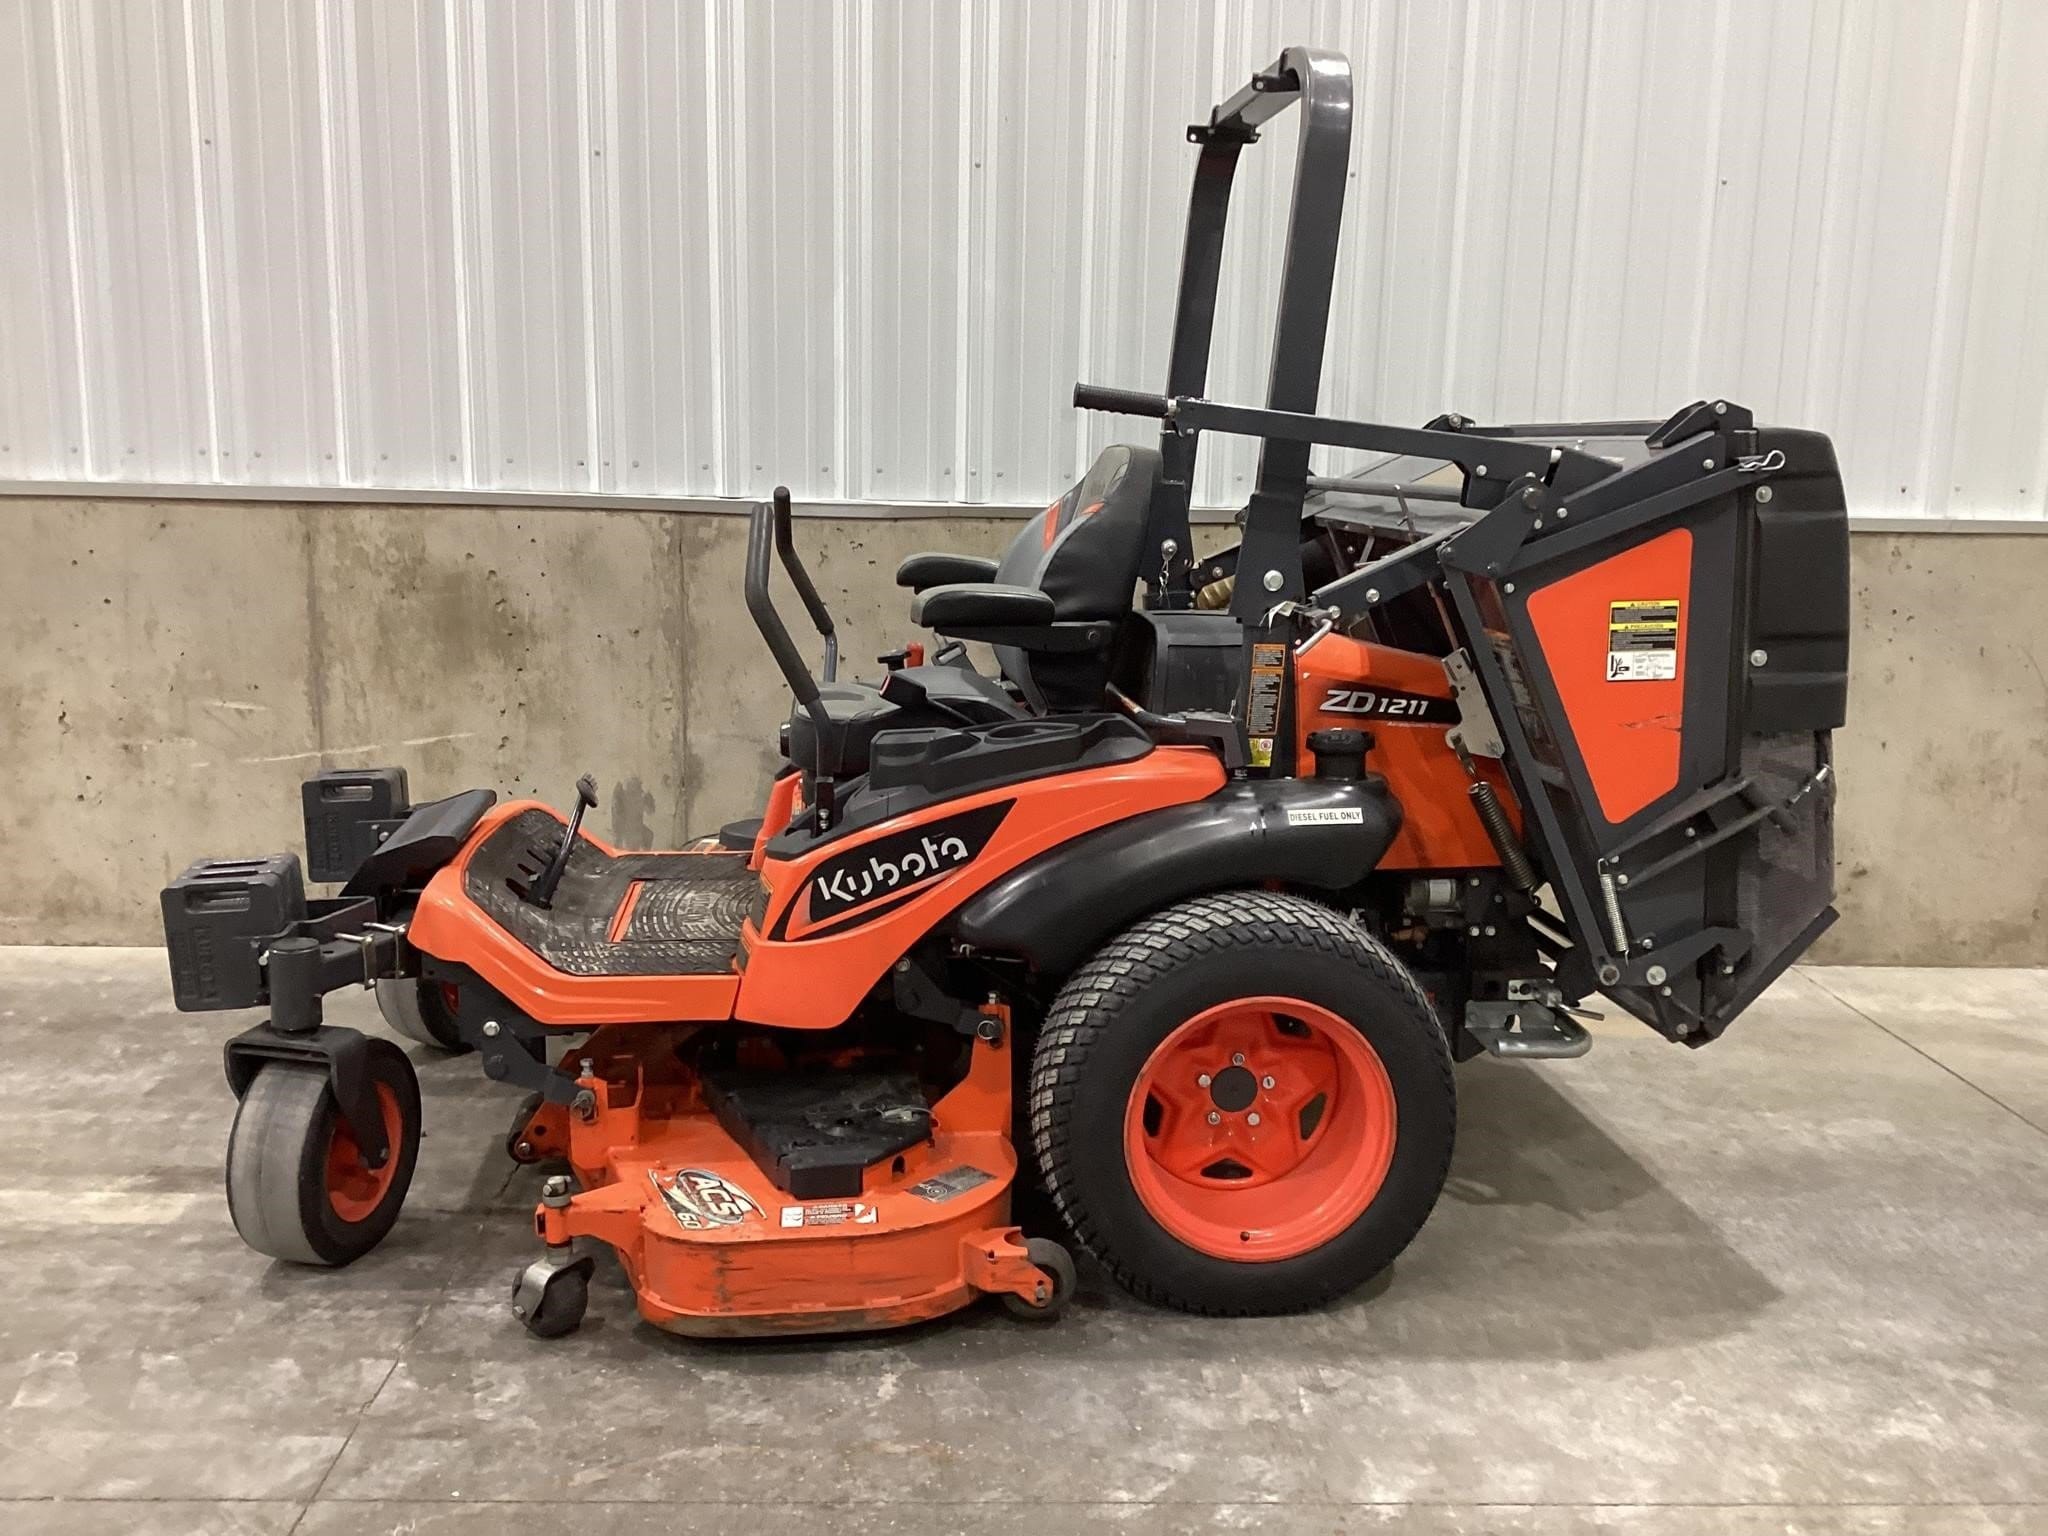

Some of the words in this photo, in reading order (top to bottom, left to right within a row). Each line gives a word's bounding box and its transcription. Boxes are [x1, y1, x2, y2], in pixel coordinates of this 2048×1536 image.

[1319, 690, 1375, 713] ZD
[1378, 698, 1429, 715] 1211
[1290, 813, 1317, 821] DIESEL
[1319, 812, 1339, 820] FUEL
[1340, 811, 1361, 820] ONLY
[818, 837, 968, 901] Kubota
[688, 1176, 741, 1215] ACS
[677, 1212, 701, 1229] 60
